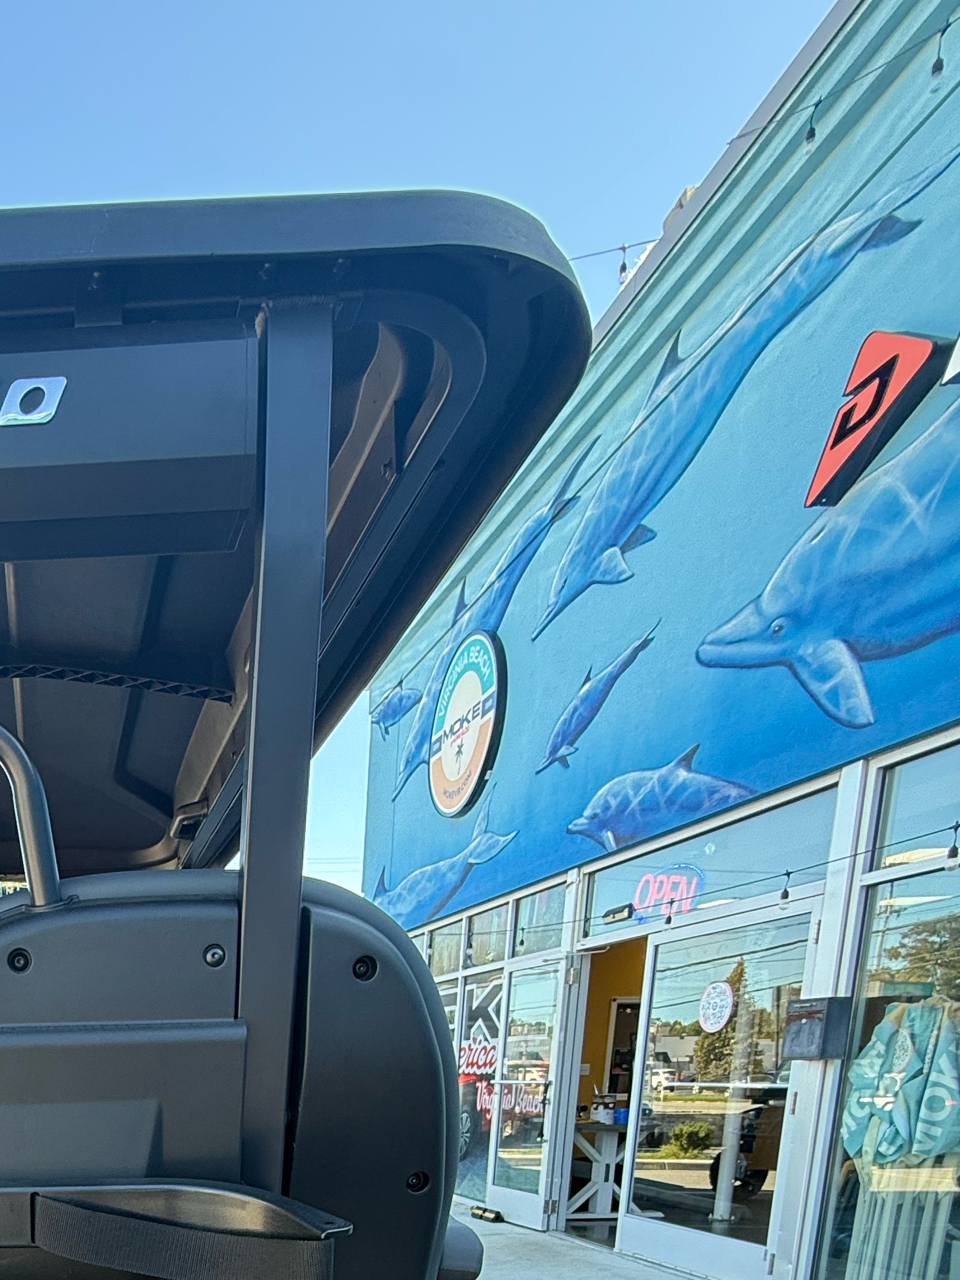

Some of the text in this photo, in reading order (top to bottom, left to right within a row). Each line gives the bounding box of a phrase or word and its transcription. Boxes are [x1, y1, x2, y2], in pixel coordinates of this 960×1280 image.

[438, 645, 491, 716] VIRGINIA BEACH
[443, 701, 481, 744] MOKE
[634, 873, 697, 914] OPEN
[912, 1045, 960, 1155] MOK
